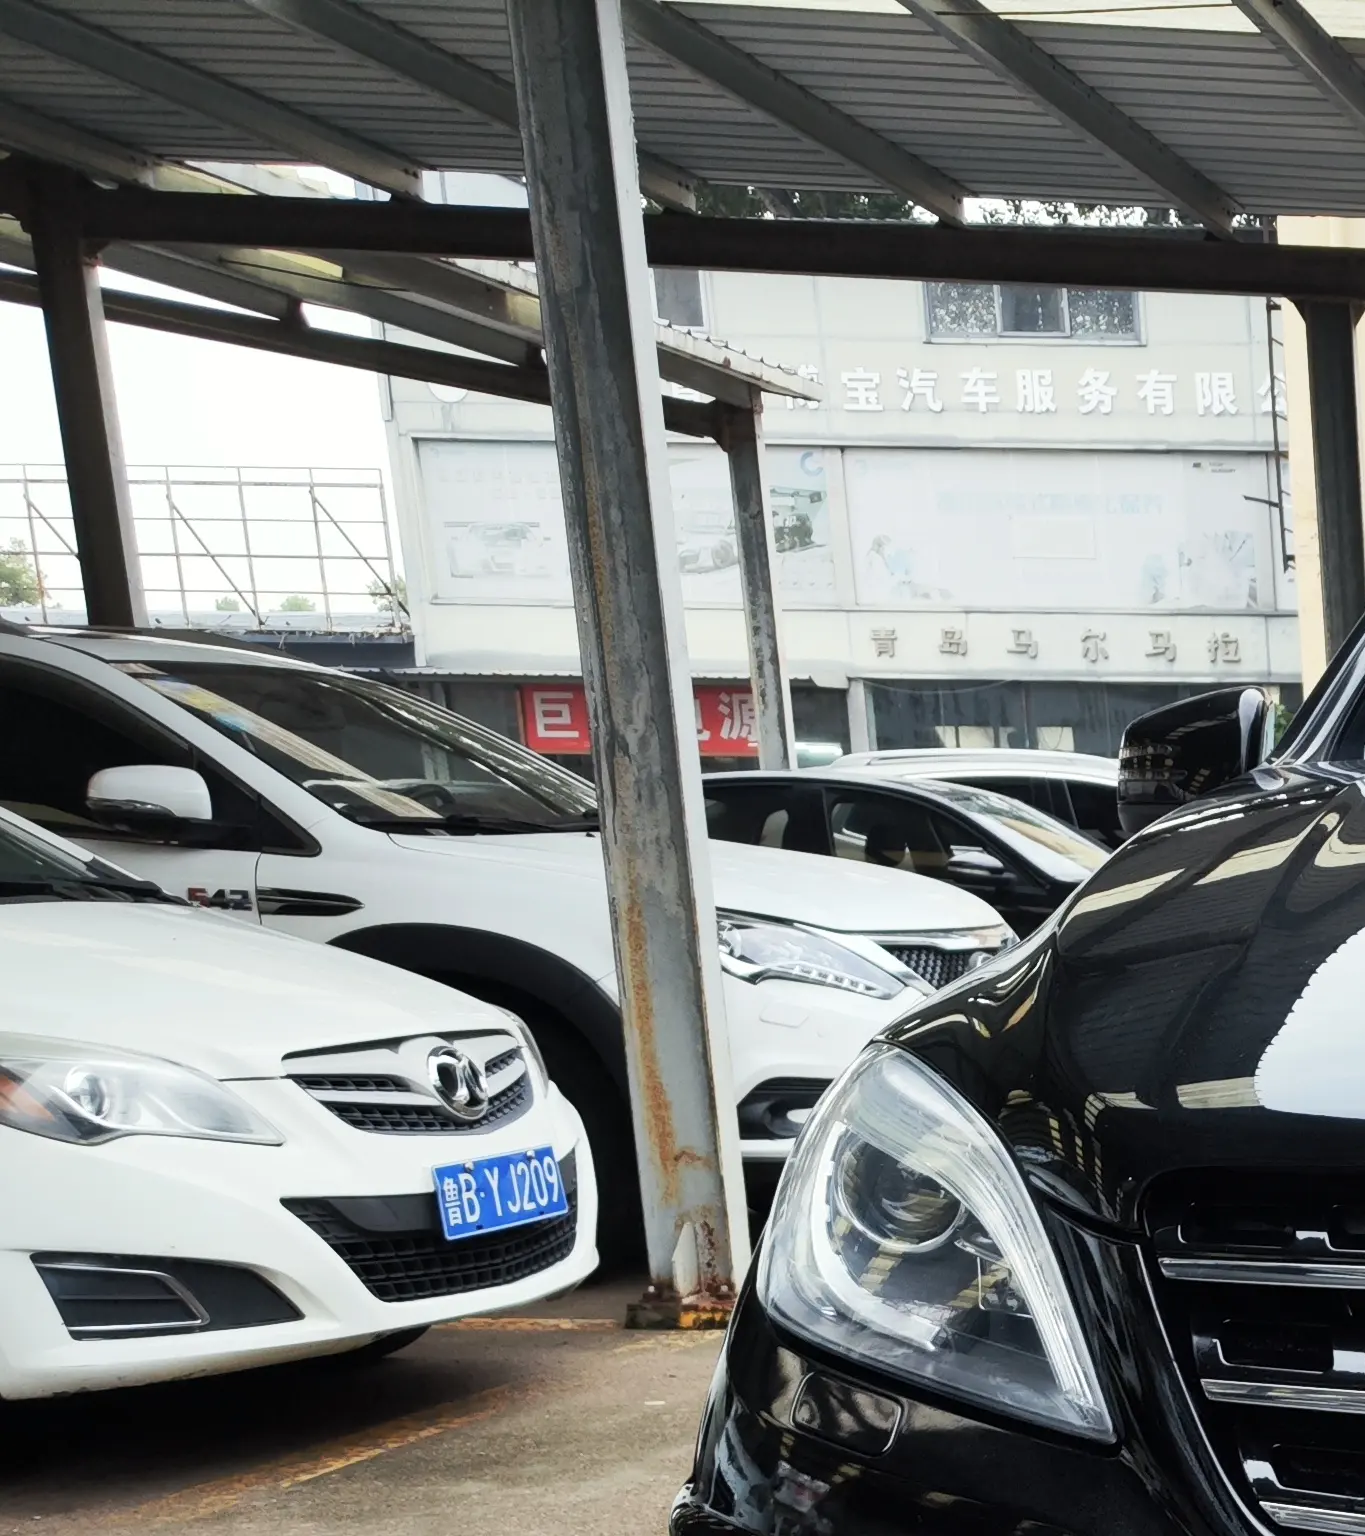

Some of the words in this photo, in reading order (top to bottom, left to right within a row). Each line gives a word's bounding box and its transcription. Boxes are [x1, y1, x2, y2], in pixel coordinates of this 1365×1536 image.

[870, 626, 1242, 664] 青岛马尔马拉
